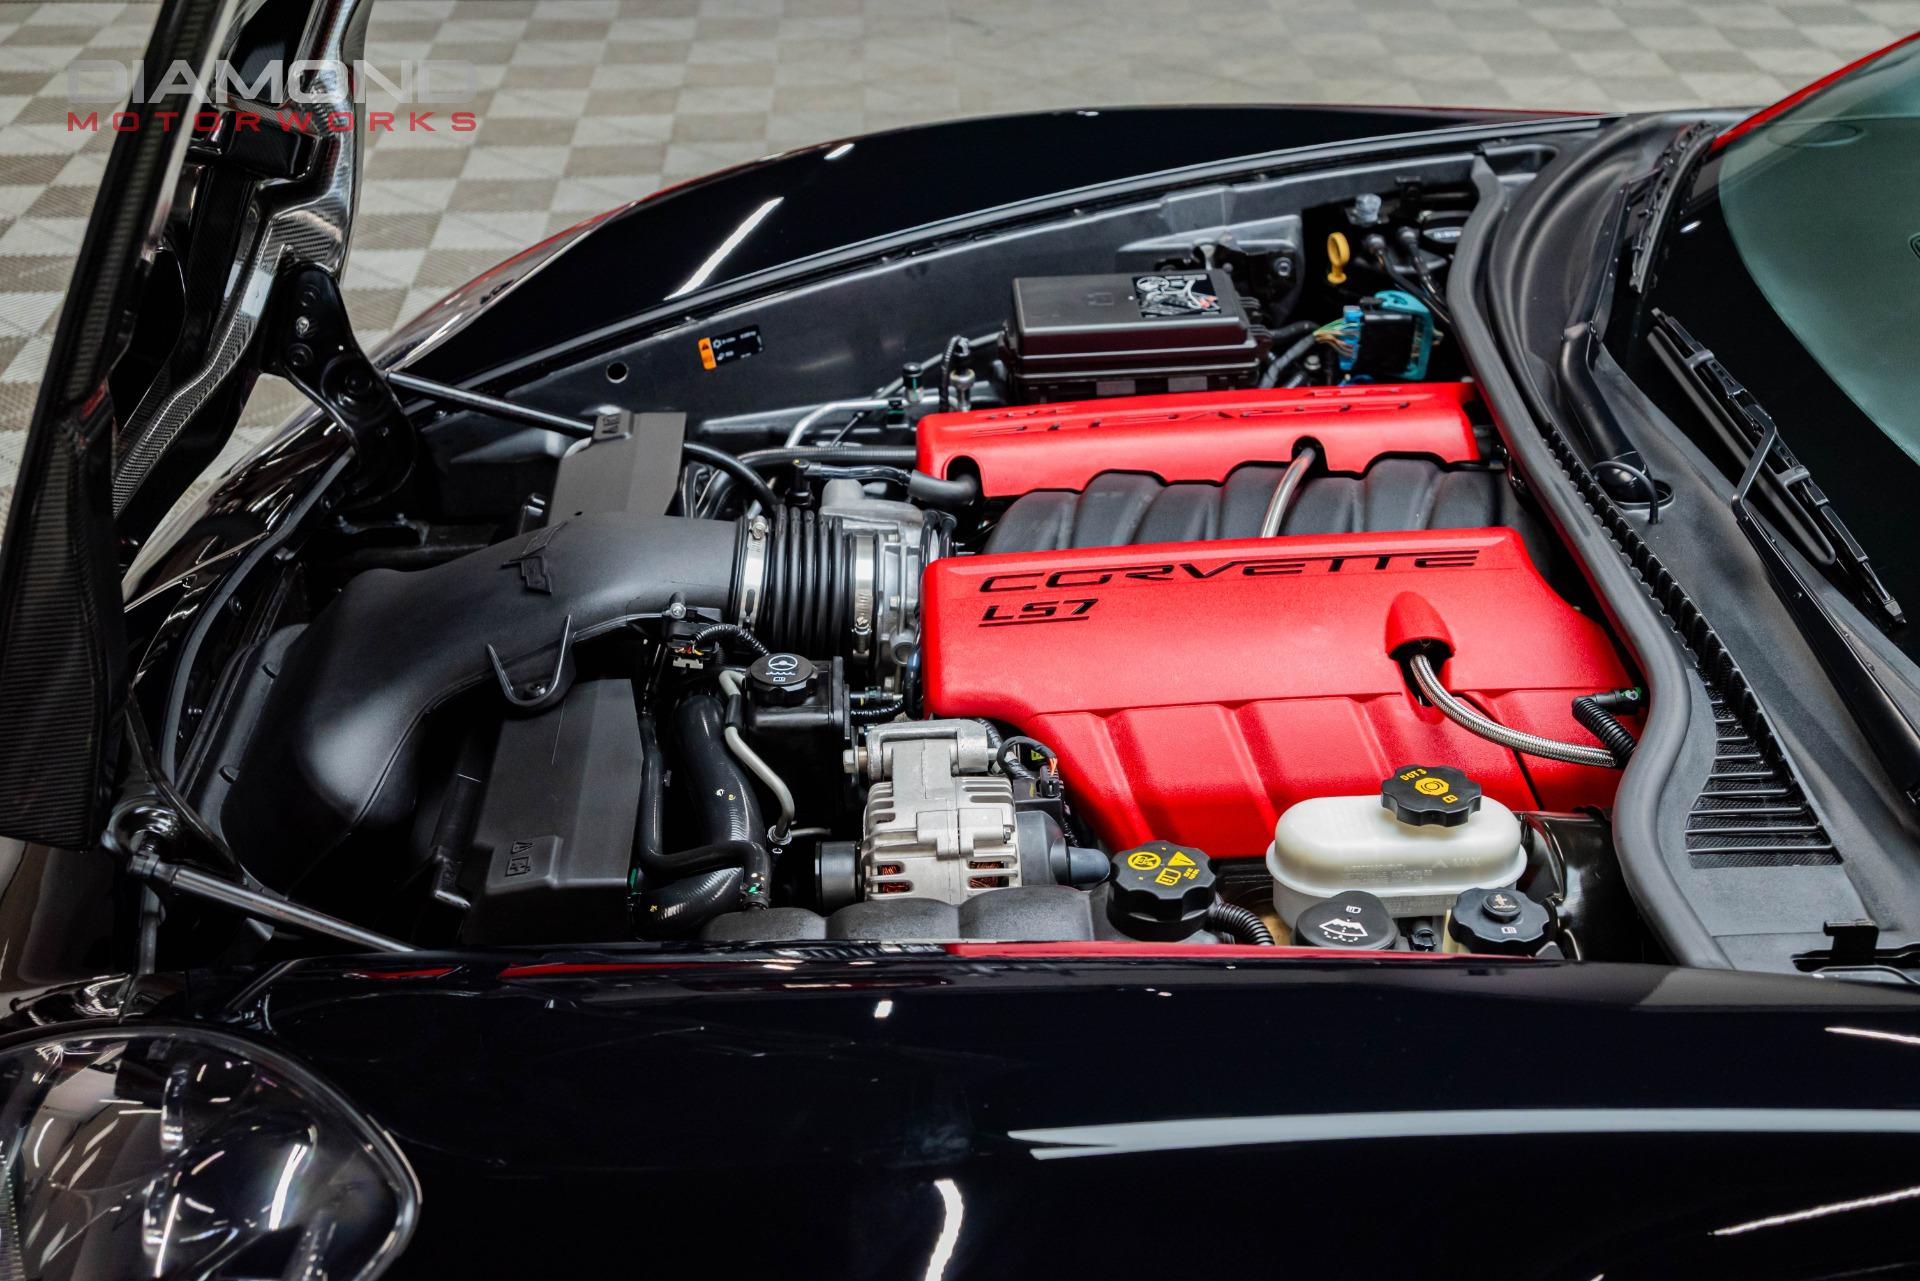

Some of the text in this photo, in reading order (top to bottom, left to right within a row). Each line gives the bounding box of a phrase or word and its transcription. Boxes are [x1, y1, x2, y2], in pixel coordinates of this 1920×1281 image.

[978, 549, 1480, 593] CORVETTE
[980, 599, 1100, 624] LS7
[1399, 770, 1420, 781] DOT
